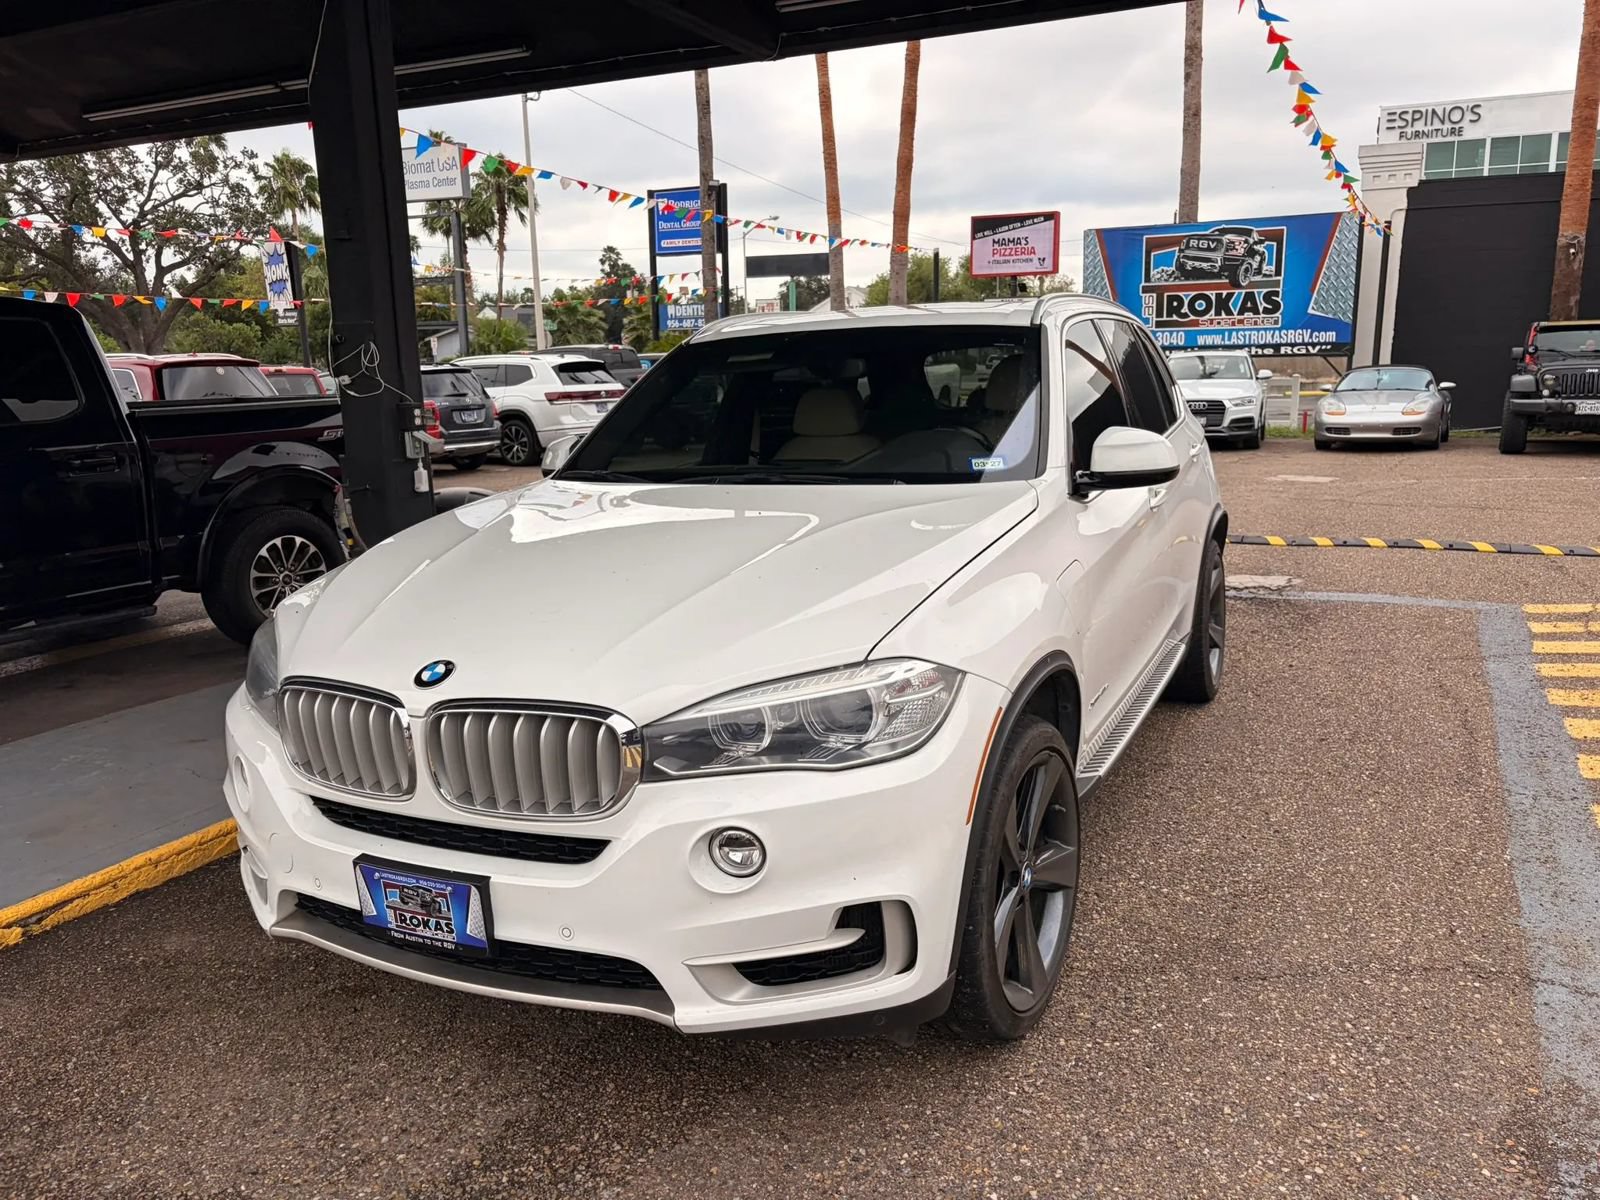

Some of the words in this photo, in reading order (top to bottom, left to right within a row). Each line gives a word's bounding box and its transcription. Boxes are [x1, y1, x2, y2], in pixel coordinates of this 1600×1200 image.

[1386, 104, 1482, 130] ESPINO'S
[1398, 126, 1464, 141] FURNITURE
[432, 176, 457, 188] Center
[992, 236, 1029, 247] MAMA'S
[1189, 239, 1217, 248] RGV
[992, 246, 1036, 257] PIZZERIA
[1153, 289, 1283, 320] TROKAS
[1197, 329, 1336, 346] www.LASTROKASRGV.com
[394, 911, 455, 935] TROKAS
